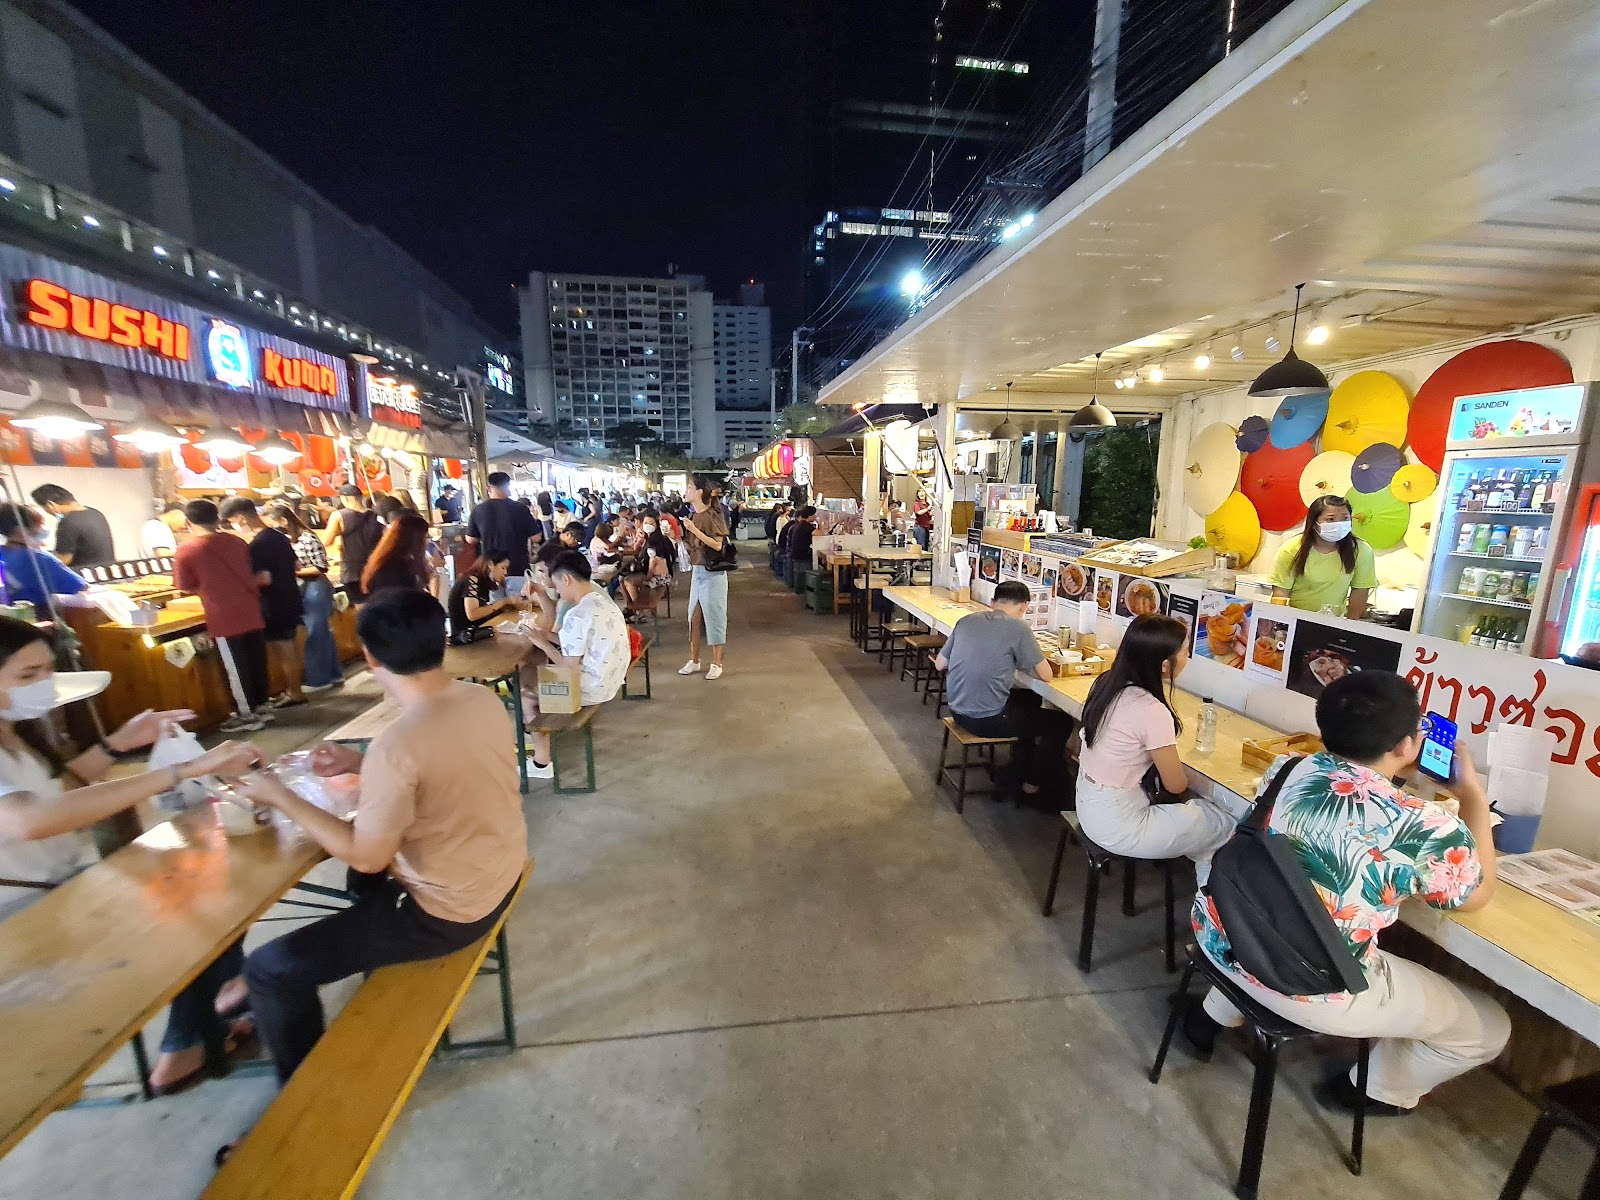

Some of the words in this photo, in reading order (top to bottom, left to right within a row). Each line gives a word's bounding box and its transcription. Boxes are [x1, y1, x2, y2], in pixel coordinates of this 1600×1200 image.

[28, 277, 190, 361] SUSHI
[1474, 400, 1509, 410] SANDEN
[1502, 502, 1518, 510] 100
